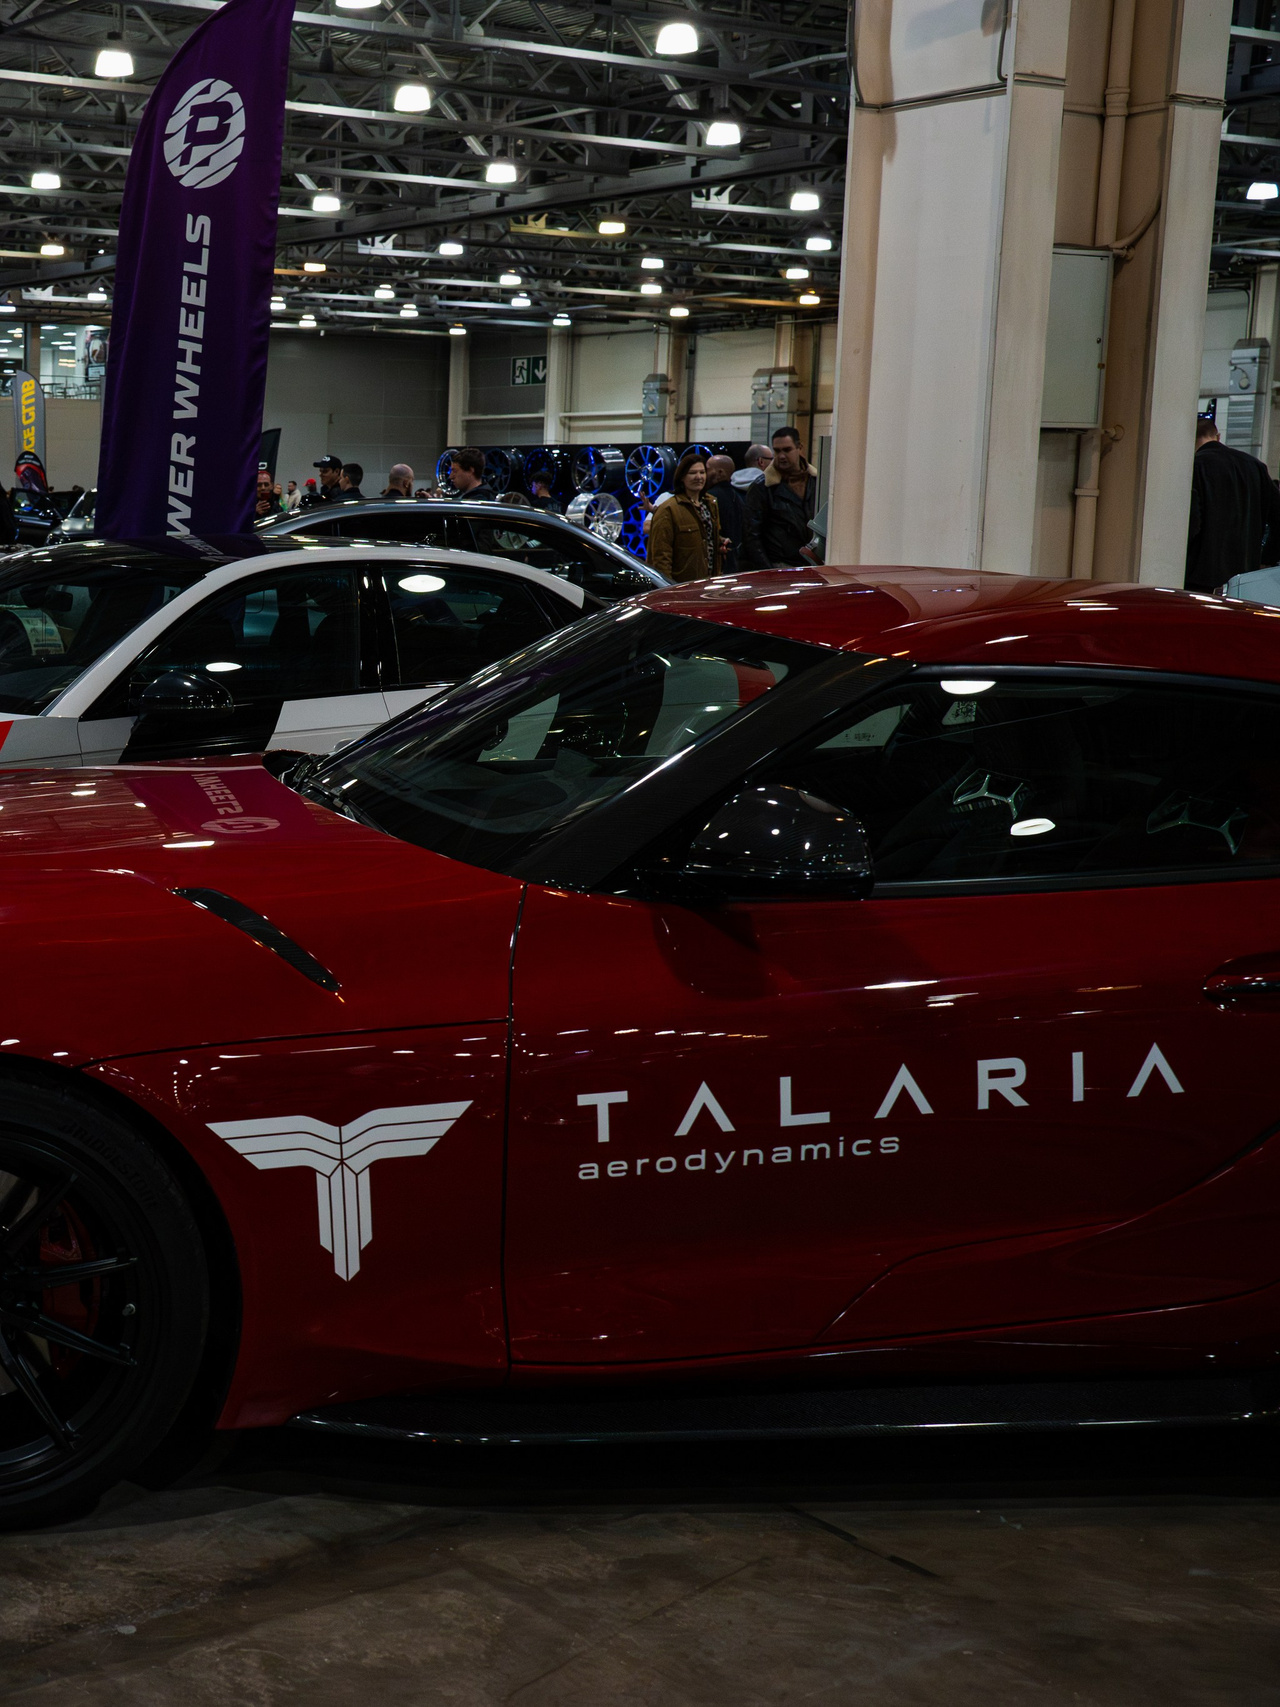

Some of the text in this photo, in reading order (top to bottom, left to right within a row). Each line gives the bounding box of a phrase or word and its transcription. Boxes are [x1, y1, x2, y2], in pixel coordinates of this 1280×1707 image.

[172, 213, 211, 420] WHEELS
[576, 1042, 1185, 1144] TALARIA
[578, 1136, 900, 1180] aerodynamics
